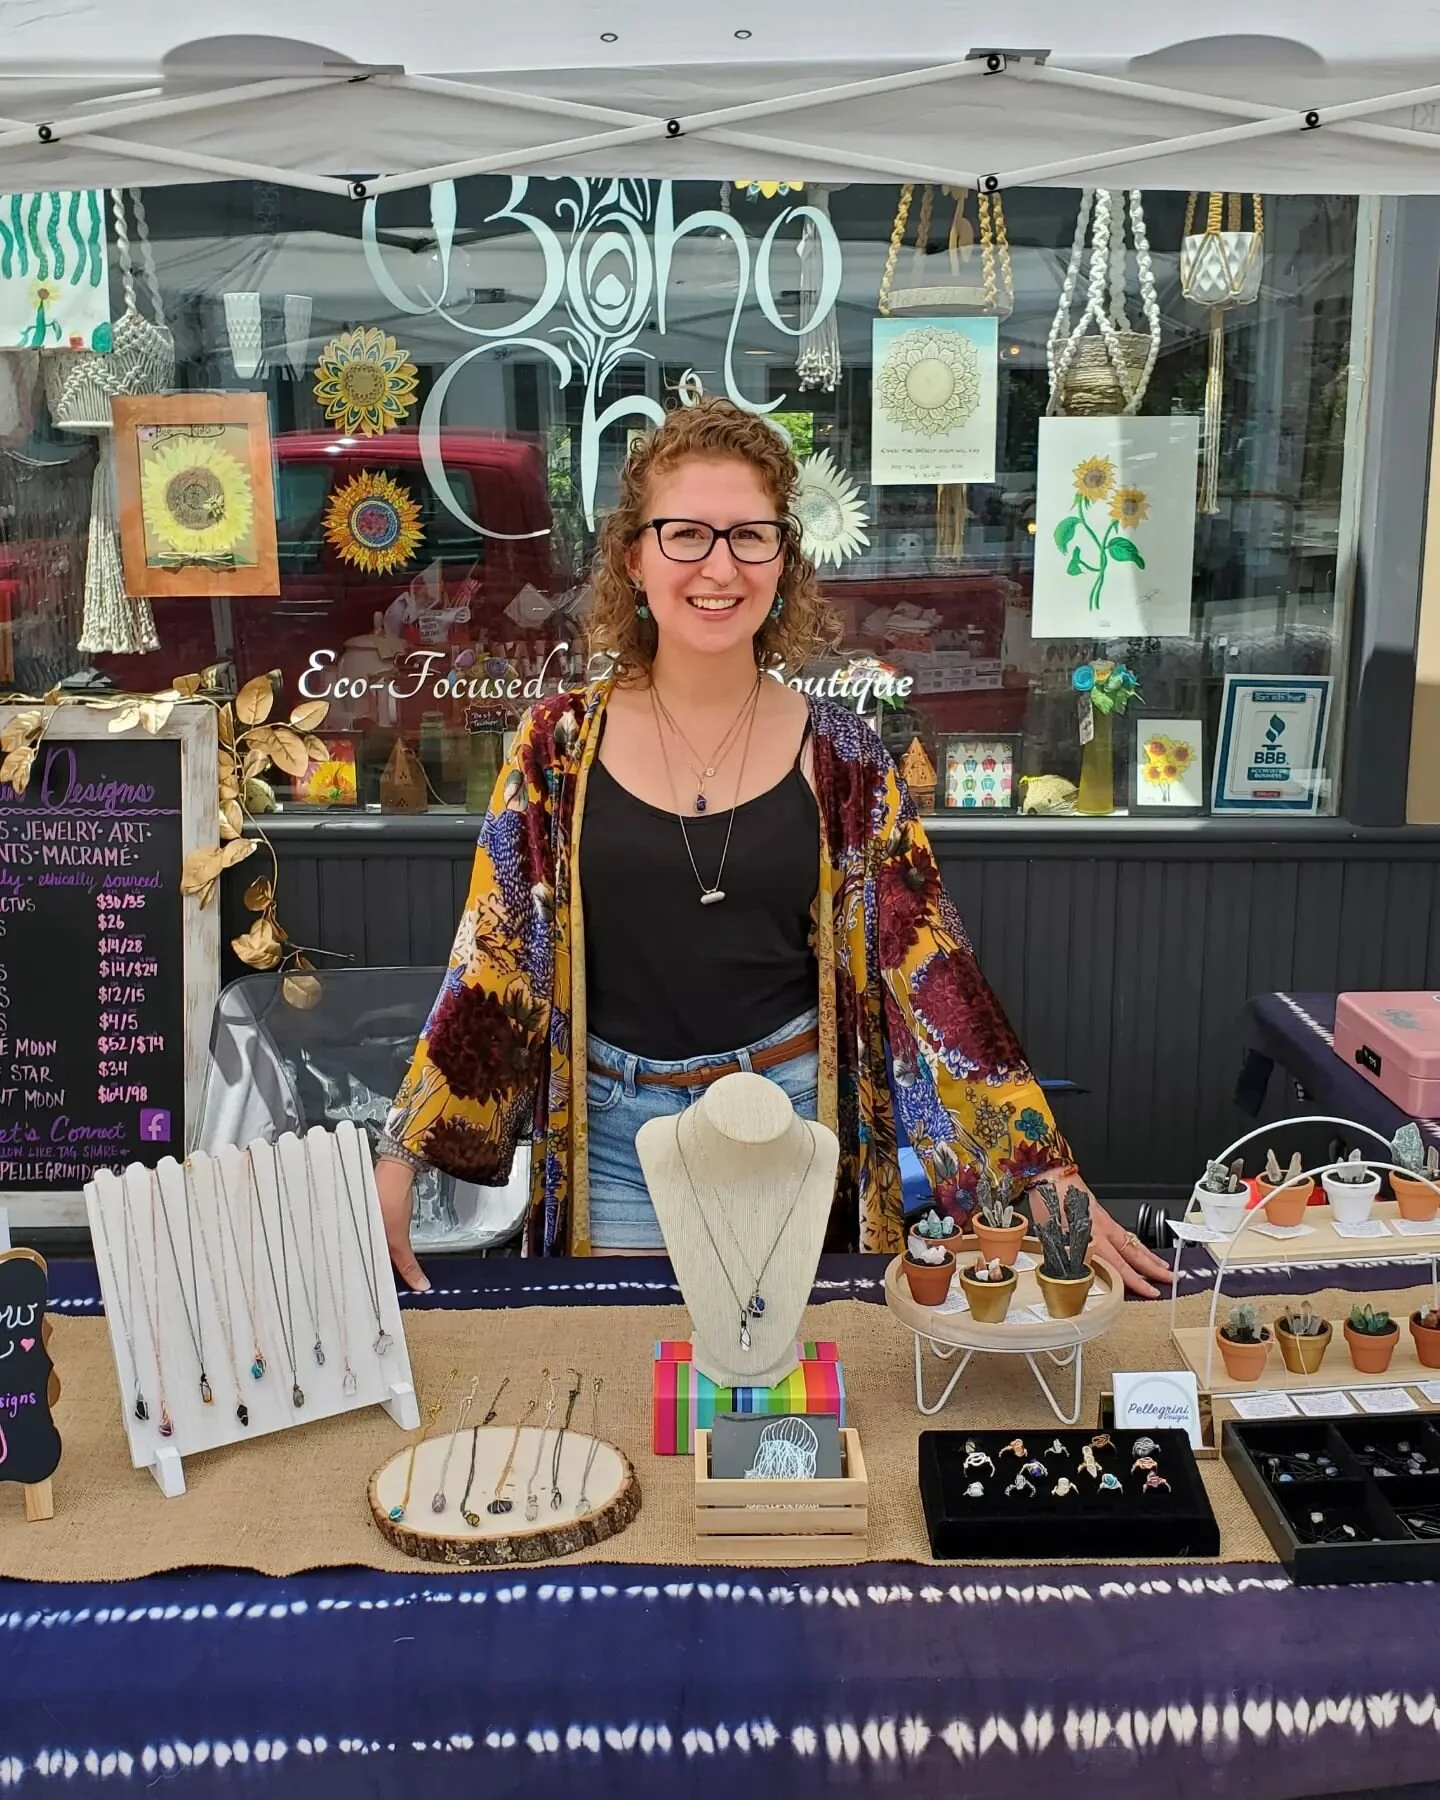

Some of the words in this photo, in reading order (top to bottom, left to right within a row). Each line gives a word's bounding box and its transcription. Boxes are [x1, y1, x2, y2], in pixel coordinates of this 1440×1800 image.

[298, 642, 569, 700] Eco-Focused
[1254, 752, 1286, 764] BBB
[41, 747, 156, 812] Designs
[38, 871, 98, 894] ethically
[103, 870, 163, 888] sourced
[98, 913, 125, 931] $26
[97, 937, 143, 956] $14/28
[99, 960, 158, 978] $14/$24
[98, 985, 146, 1005] $12/15
[98, 1012, 138, 1031] $4/5
[15, 1038, 57, 1058] MOON
[10, 1064, 54, 1083] STAR
[98, 1060, 128, 1077] $34
[24, 1089, 65, 1112] MOON
[50, 1115, 126, 1142] Connect
[83, 1144, 118, 1158] SHARE
[1128, 1402, 1190, 1420] Pellegrini
[1163, 1413, 1190, 1423] Designs
